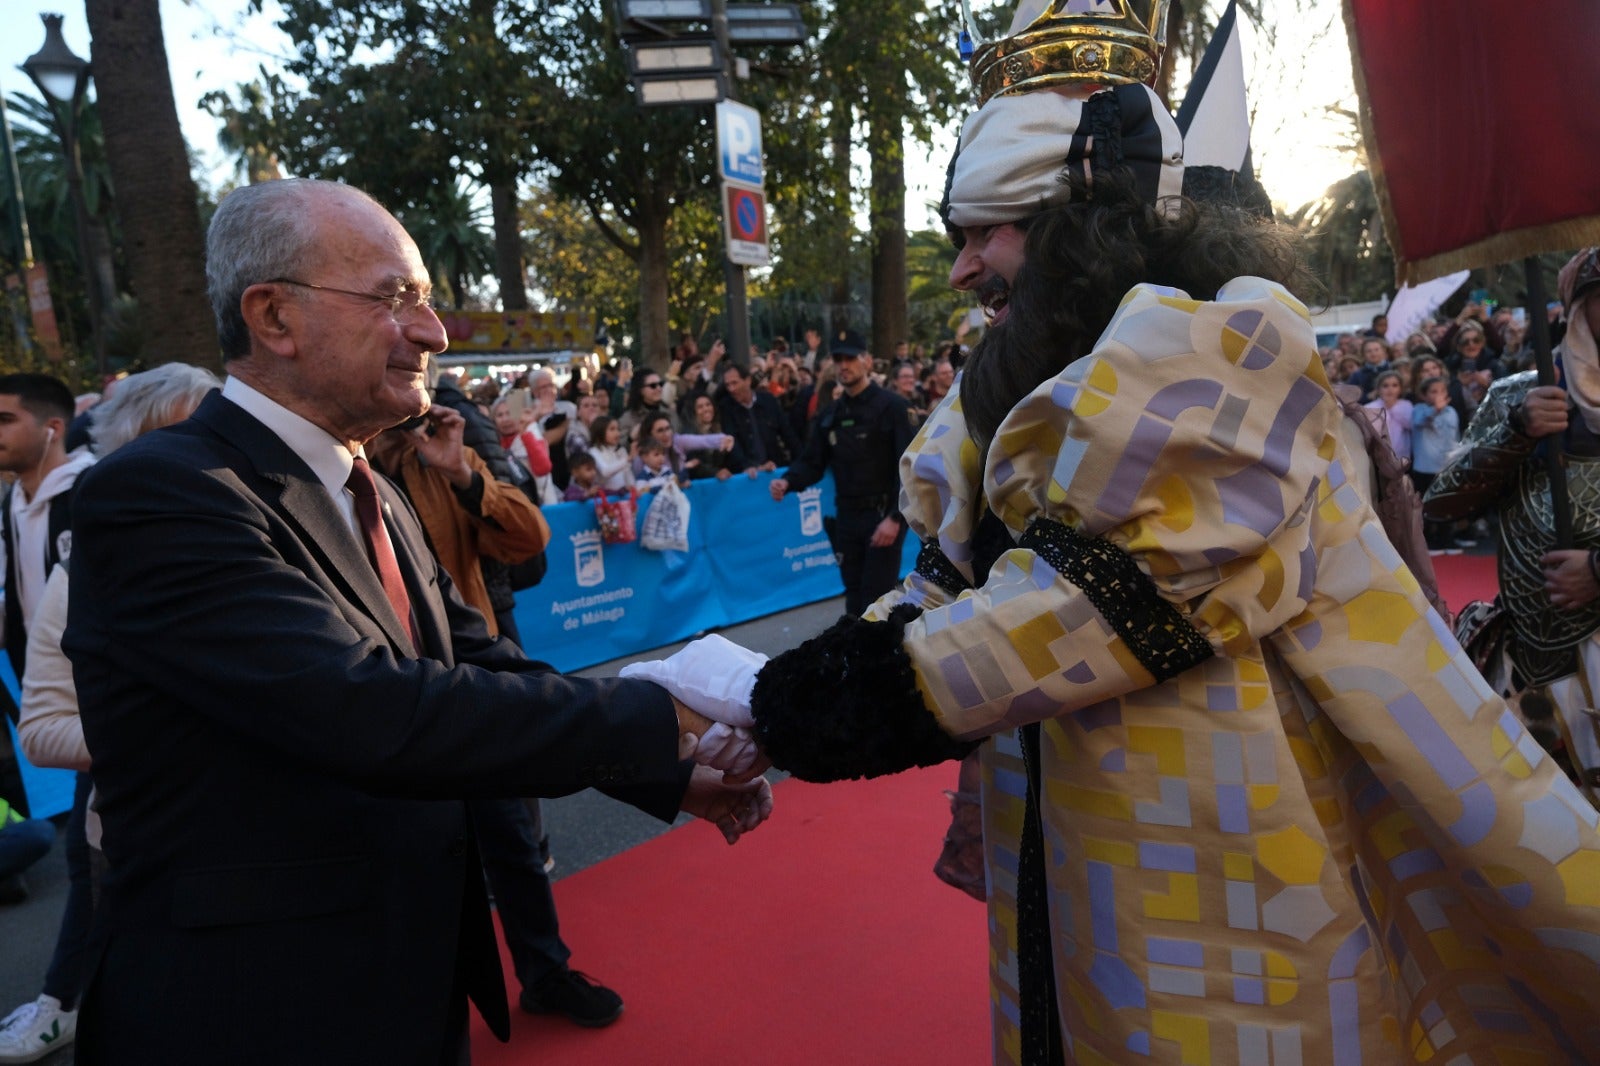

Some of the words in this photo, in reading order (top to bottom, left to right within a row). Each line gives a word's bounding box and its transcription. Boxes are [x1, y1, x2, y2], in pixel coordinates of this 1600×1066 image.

[728, 115, 751, 170] P
[551, 587, 633, 616] Ayuntamiento
[563, 617, 579, 631] de
[582, 607, 625, 626] Málaga
